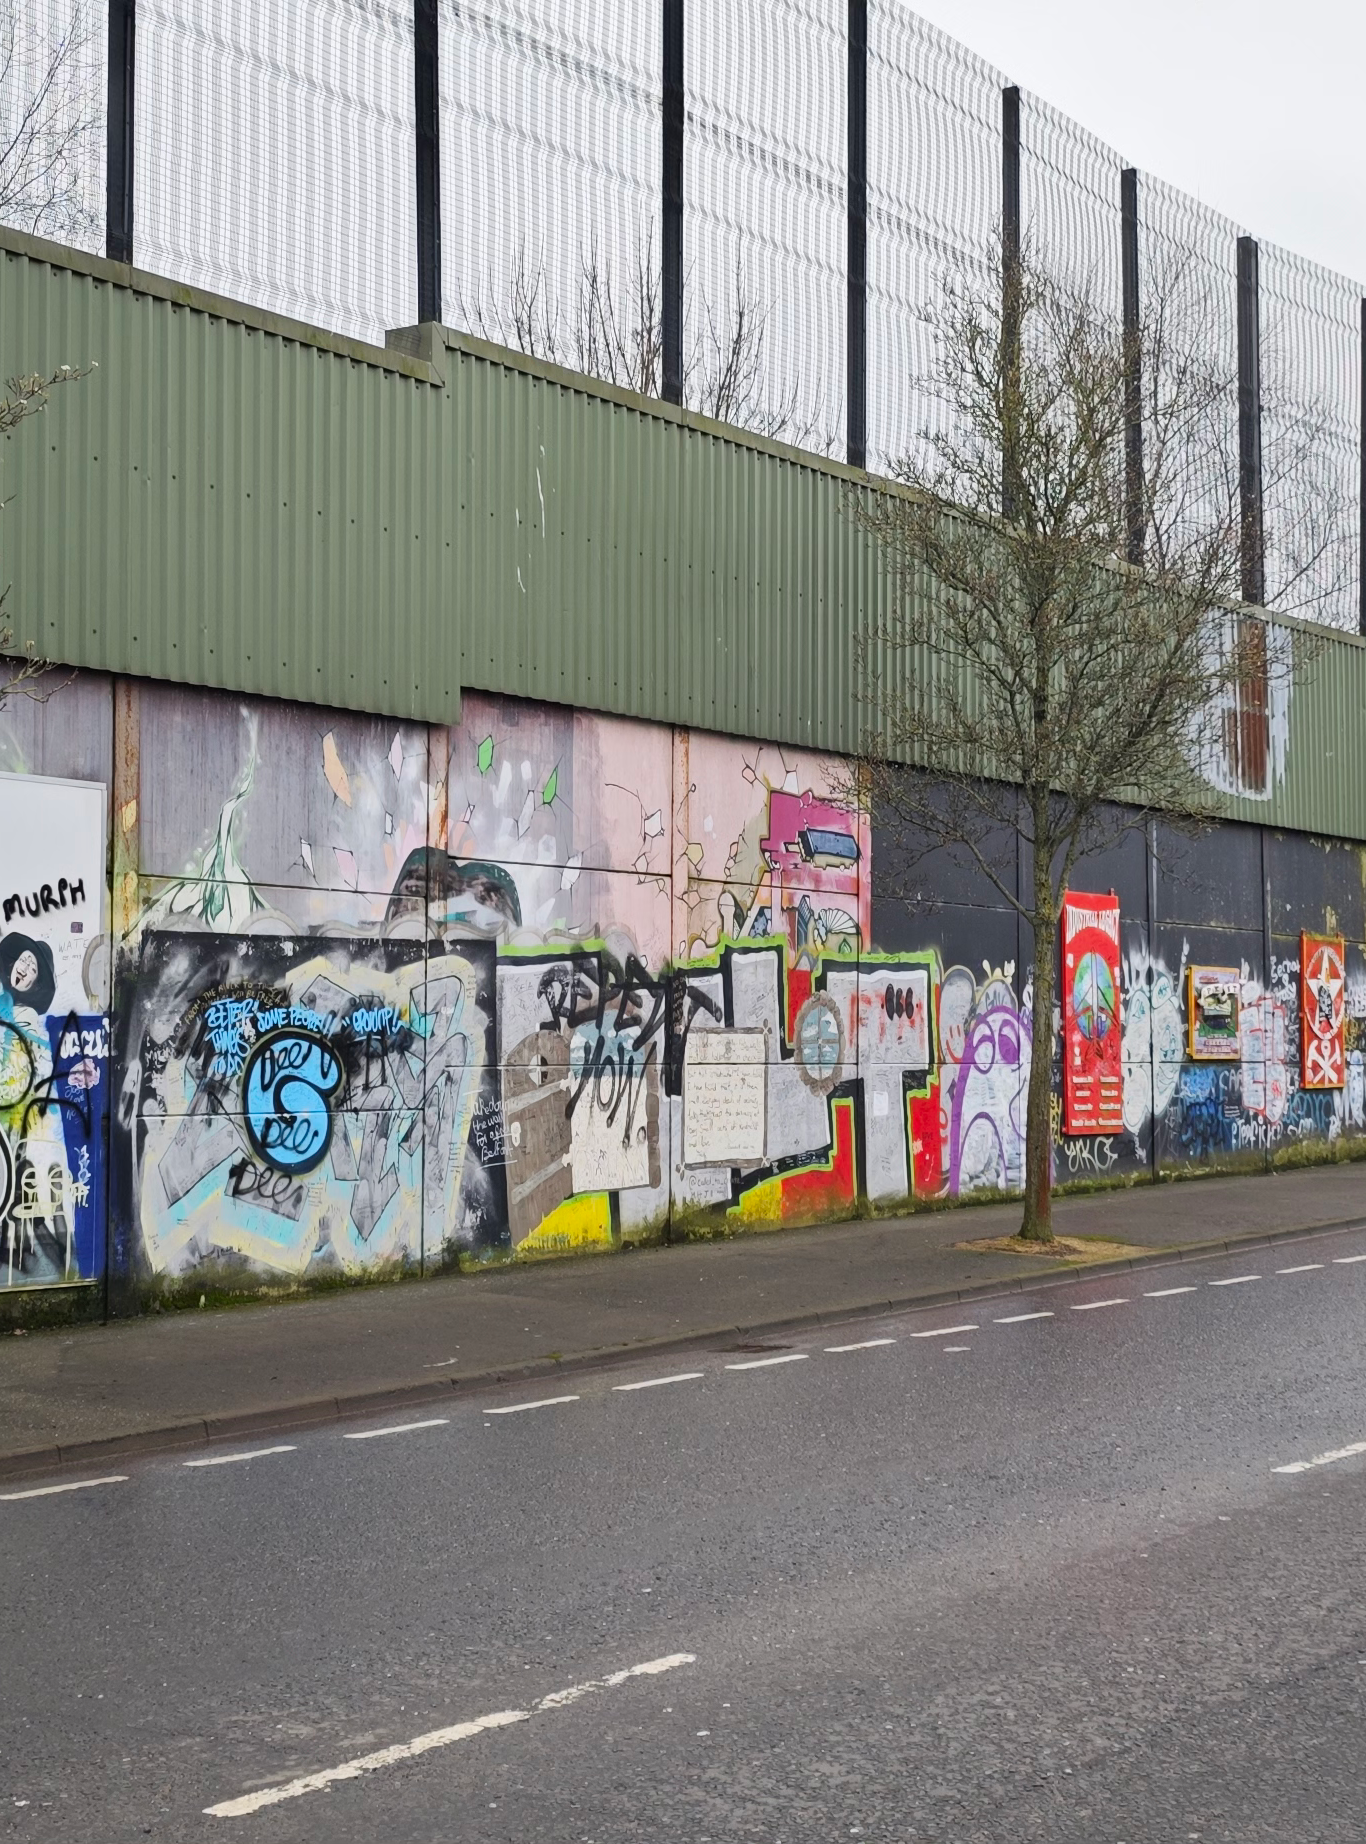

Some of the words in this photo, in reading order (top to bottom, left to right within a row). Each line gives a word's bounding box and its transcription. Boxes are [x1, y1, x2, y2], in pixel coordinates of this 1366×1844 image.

[2, 877, 87, 922] MURPH
[257, 1009, 289, 1033] SOME
[260, 1117, 319, 1155] Dee
[232, 1157, 305, 1205] Dee
